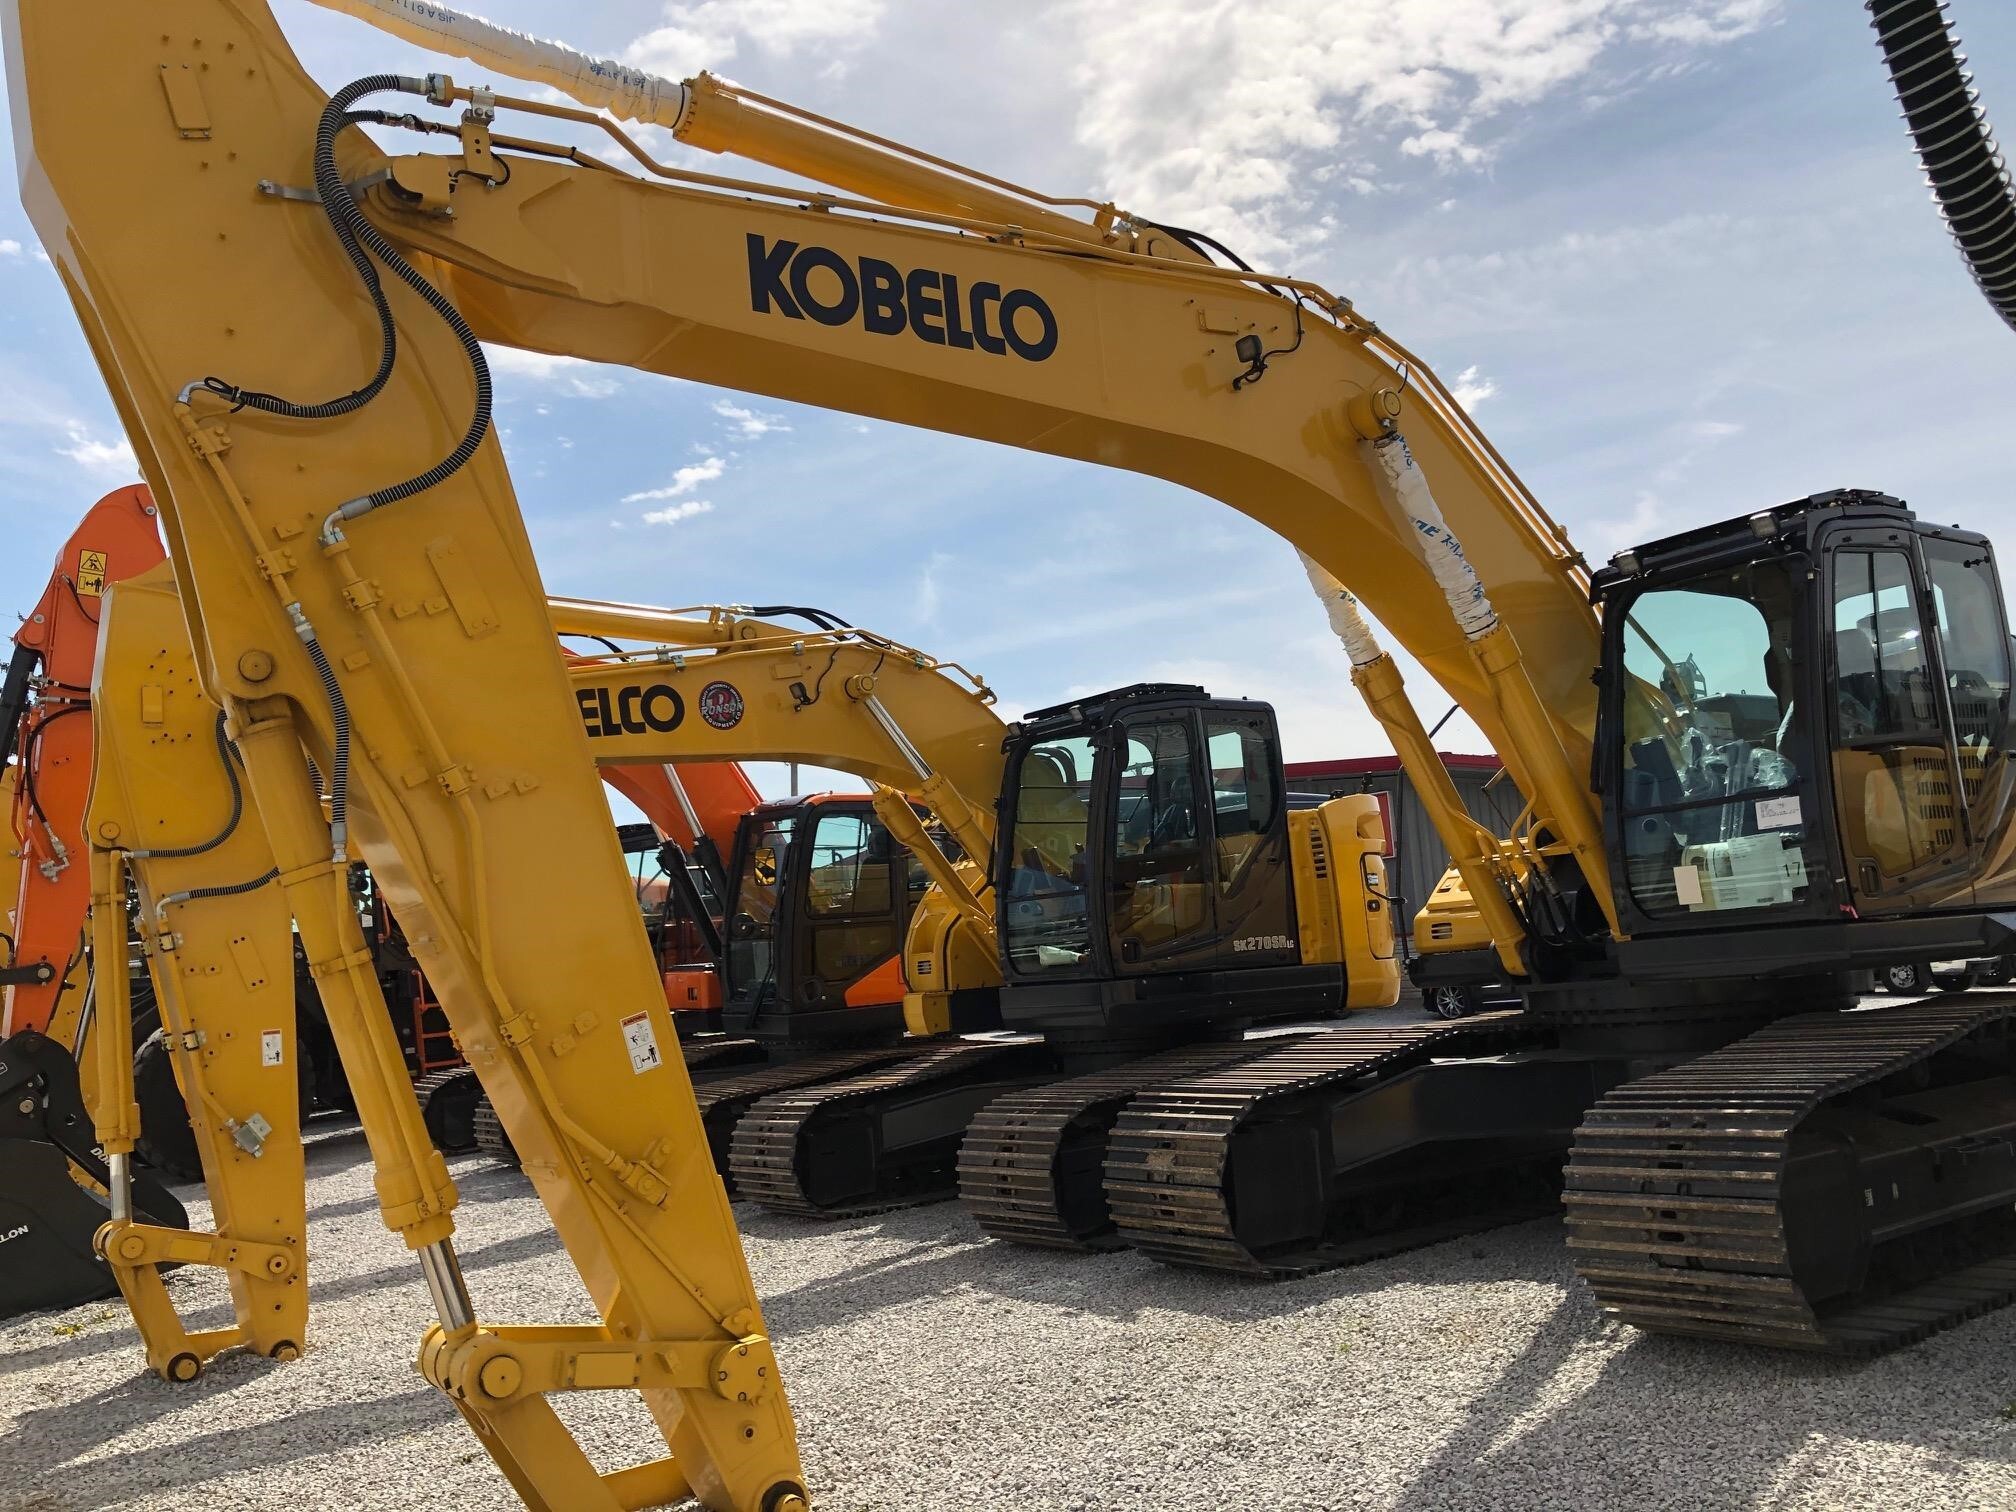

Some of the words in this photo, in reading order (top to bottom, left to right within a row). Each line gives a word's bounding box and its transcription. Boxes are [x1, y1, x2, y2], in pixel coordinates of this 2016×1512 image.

[746, 233, 1058, 362] KOBELCO
[576, 684, 685, 738] ELCO
[0, 1224, 29, 1244] LON
